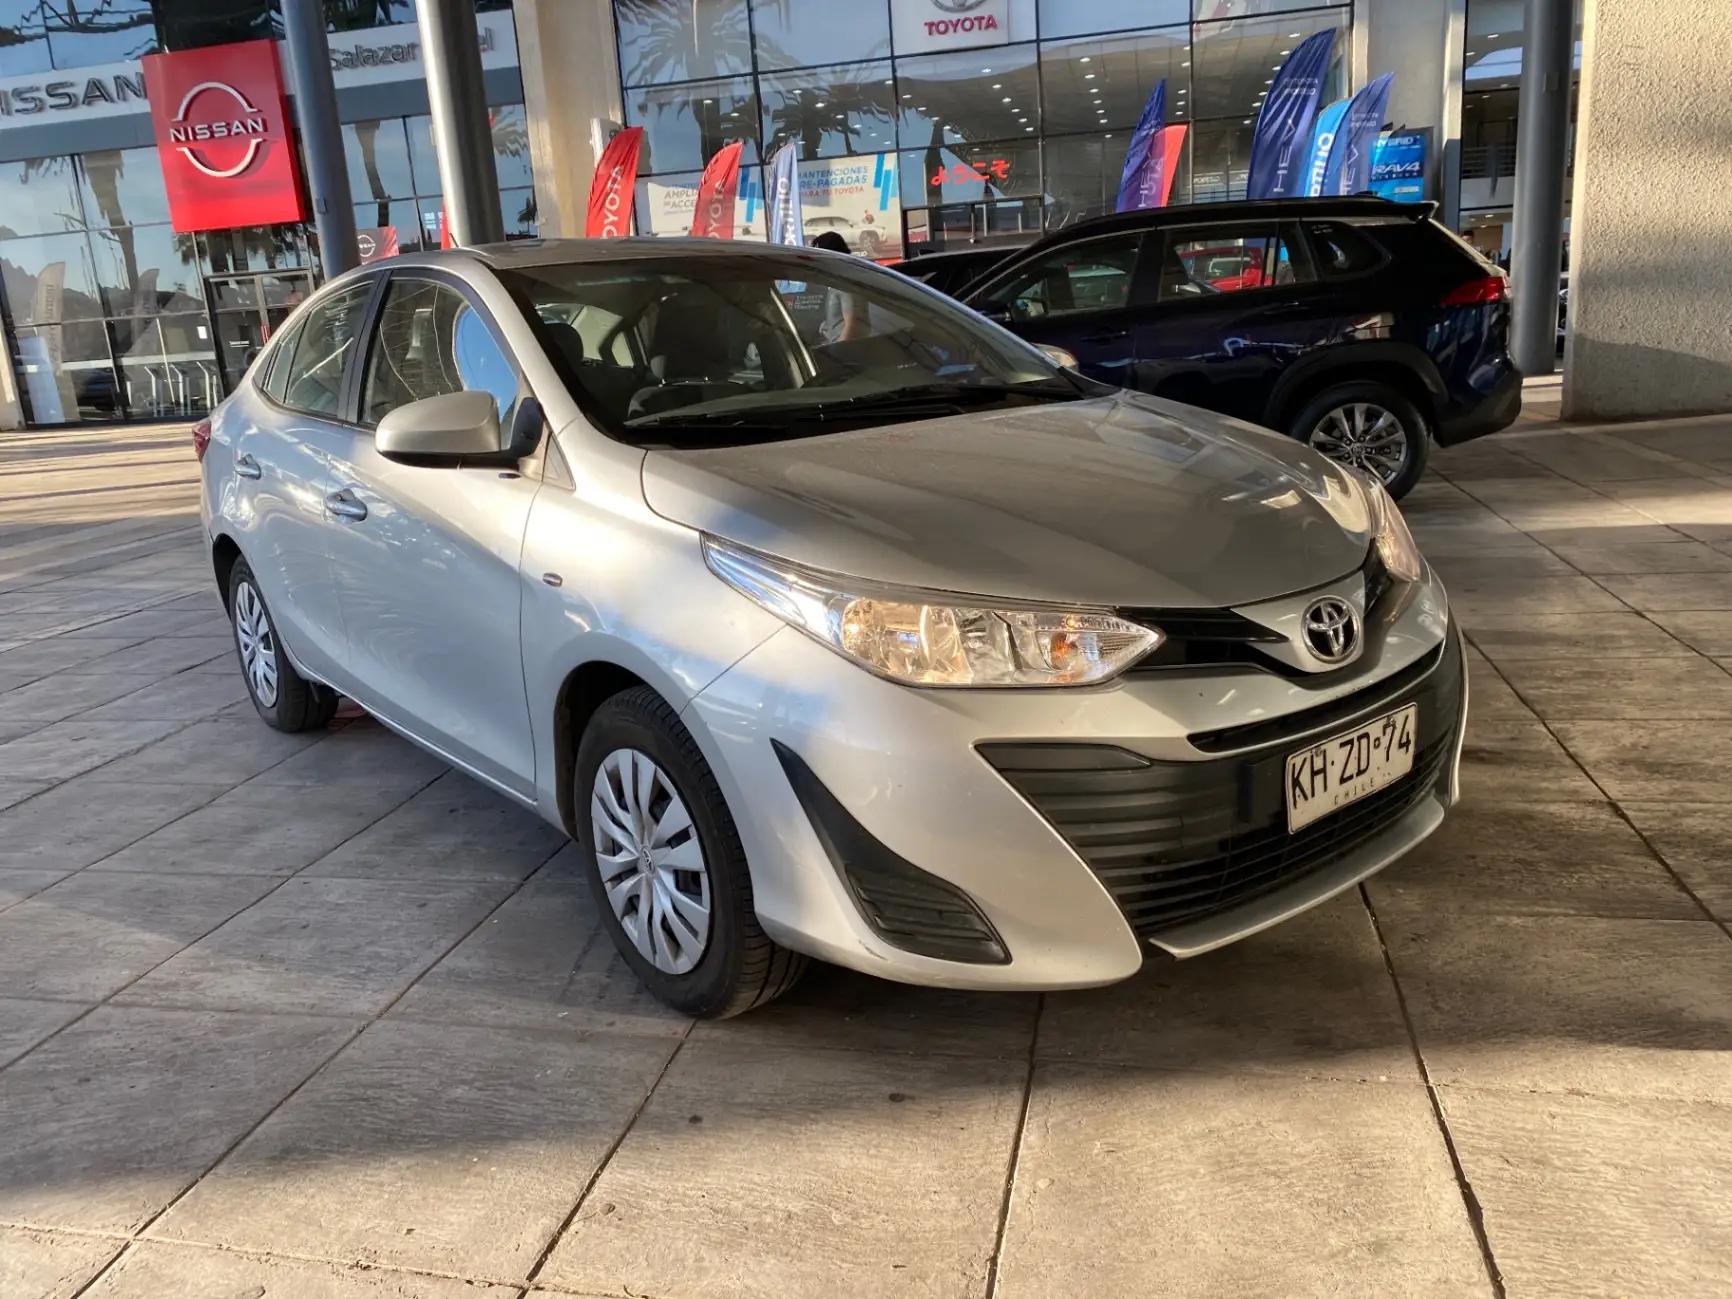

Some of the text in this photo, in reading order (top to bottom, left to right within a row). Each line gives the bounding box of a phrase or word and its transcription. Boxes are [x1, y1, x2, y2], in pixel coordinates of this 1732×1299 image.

[924, 14, 998, 36] TOYOTA
[169, 117, 266, 143] NISSAN
[930, 159, 1010, 187] ようこそ
[1371, 161, 1421, 176] RAV4
[834, 186, 865, 196] TOYOTA
[1334, 777, 1375, 805] CHILE
